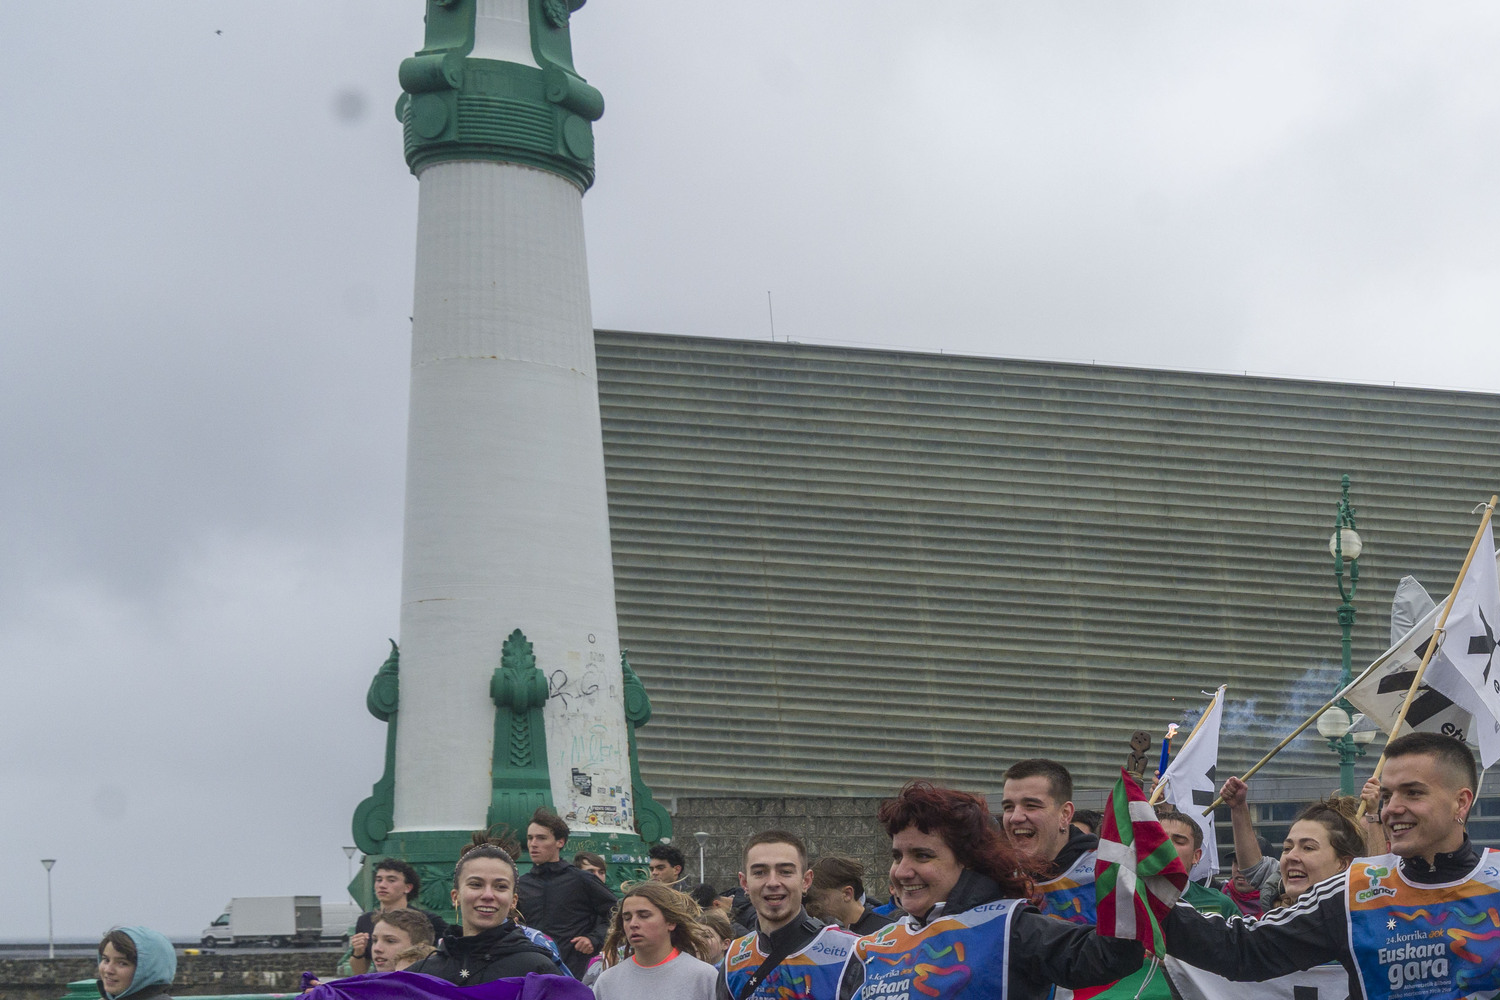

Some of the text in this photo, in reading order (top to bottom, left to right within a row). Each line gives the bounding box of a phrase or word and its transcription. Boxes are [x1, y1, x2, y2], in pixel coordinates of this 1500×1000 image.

[1386, 930, 1427, 945] 24.korrika
[823, 946, 848, 957] eitb
[1378, 942, 1446, 965] Euskara
[1388, 957, 1449, 990] gara
[861, 978, 910, 1000] Euskara
